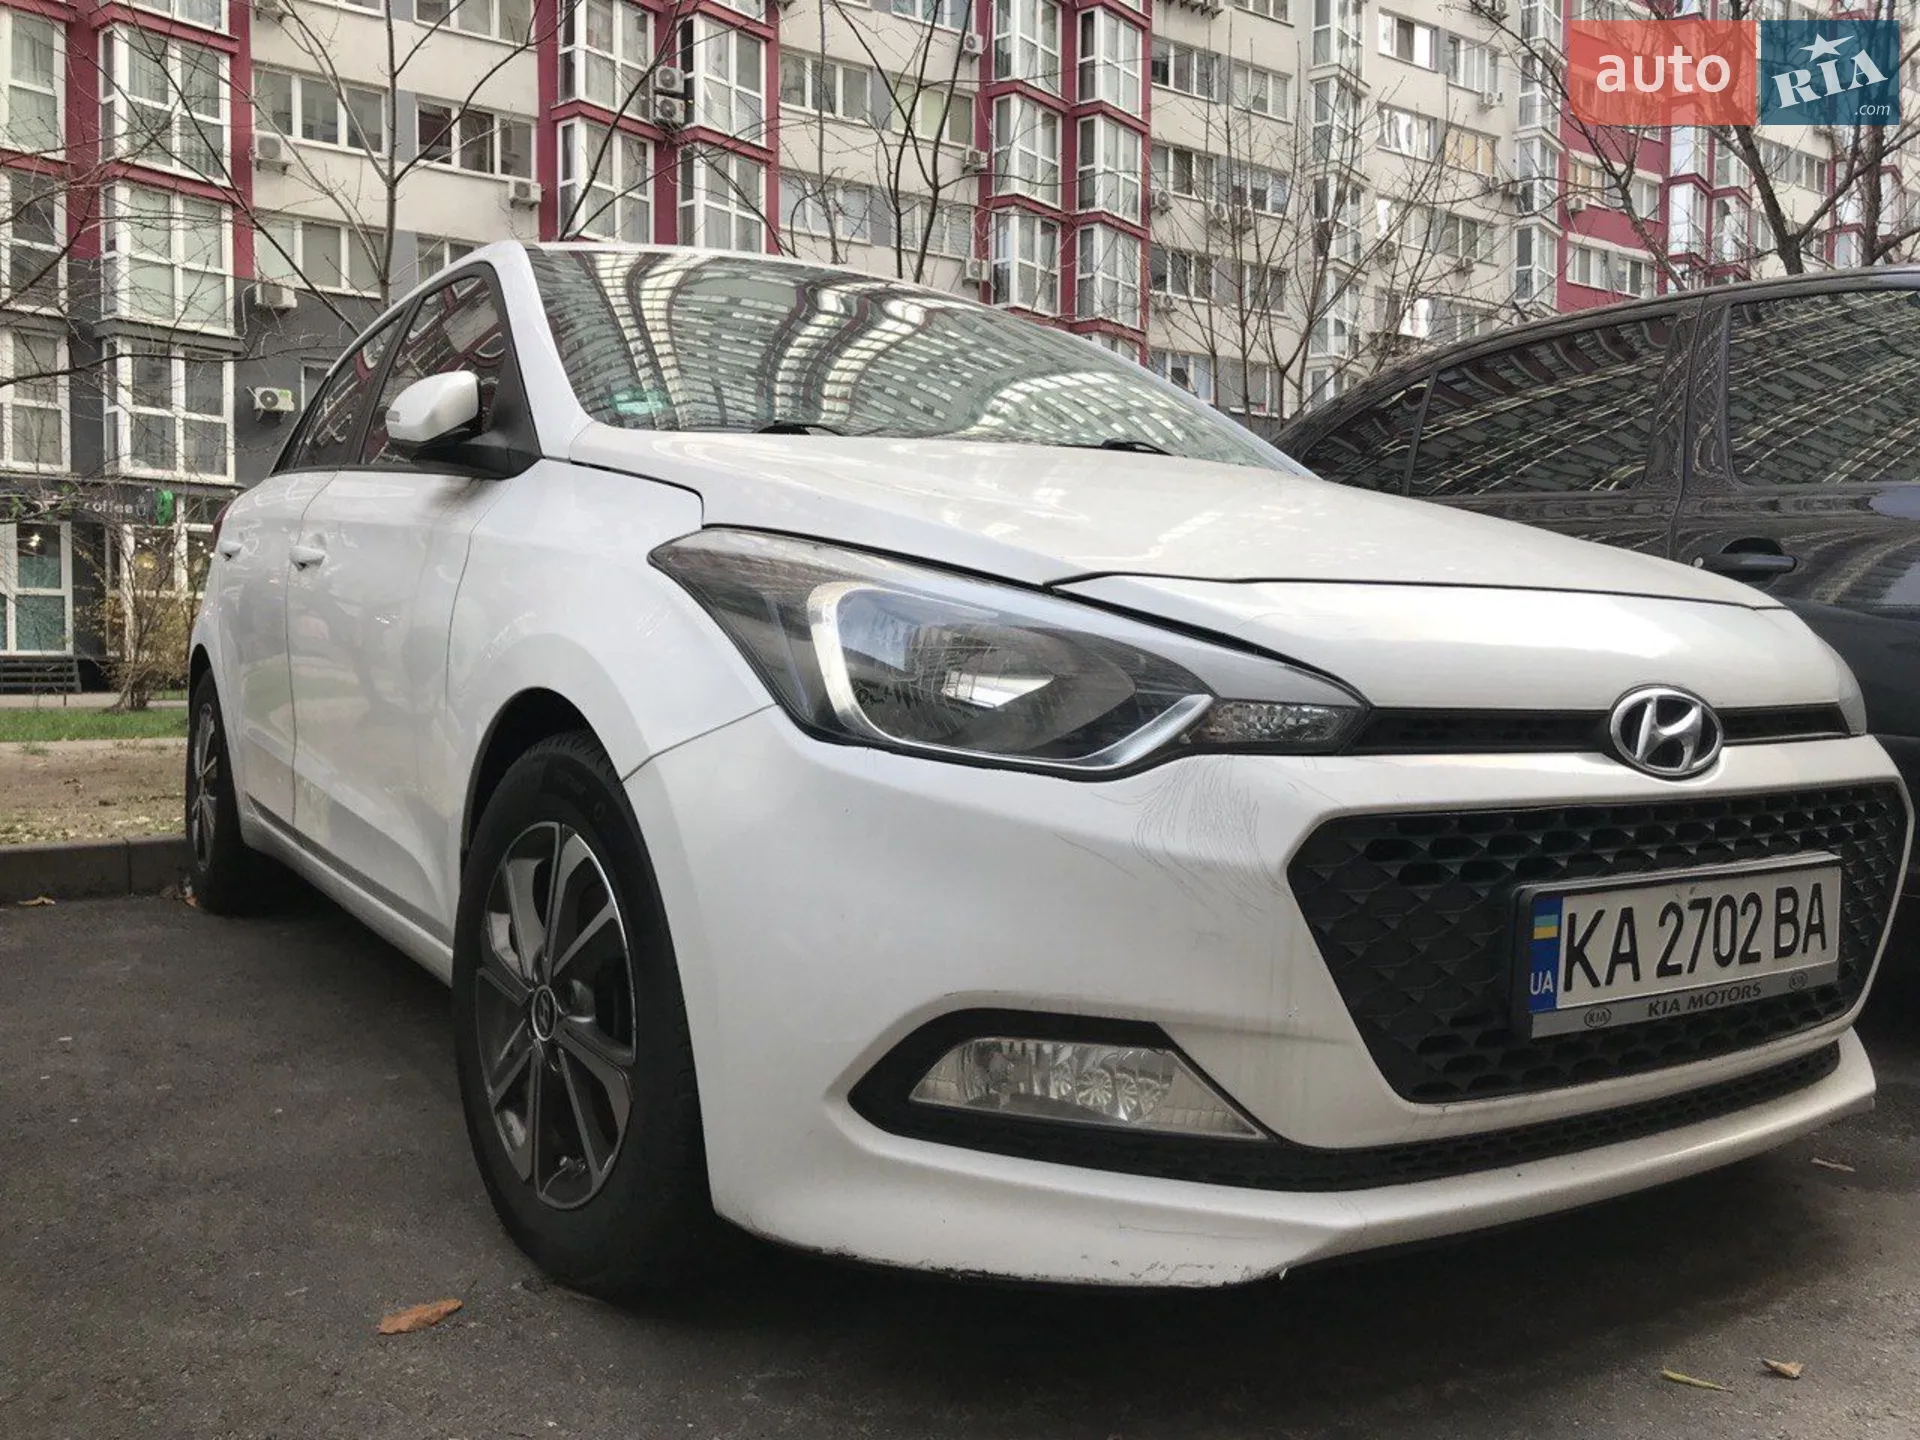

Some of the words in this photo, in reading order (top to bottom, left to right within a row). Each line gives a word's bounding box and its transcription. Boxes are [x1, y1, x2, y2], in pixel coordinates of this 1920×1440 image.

[1563, 906, 1641, 992] KA
[1656, 892, 1763, 978] 2702
[1774, 882, 1827, 959] BA
[1530, 970, 1554, 996] UA
[1647, 998, 1681, 1017] KIA
[1687, 983, 1762, 1010] MOTORS
